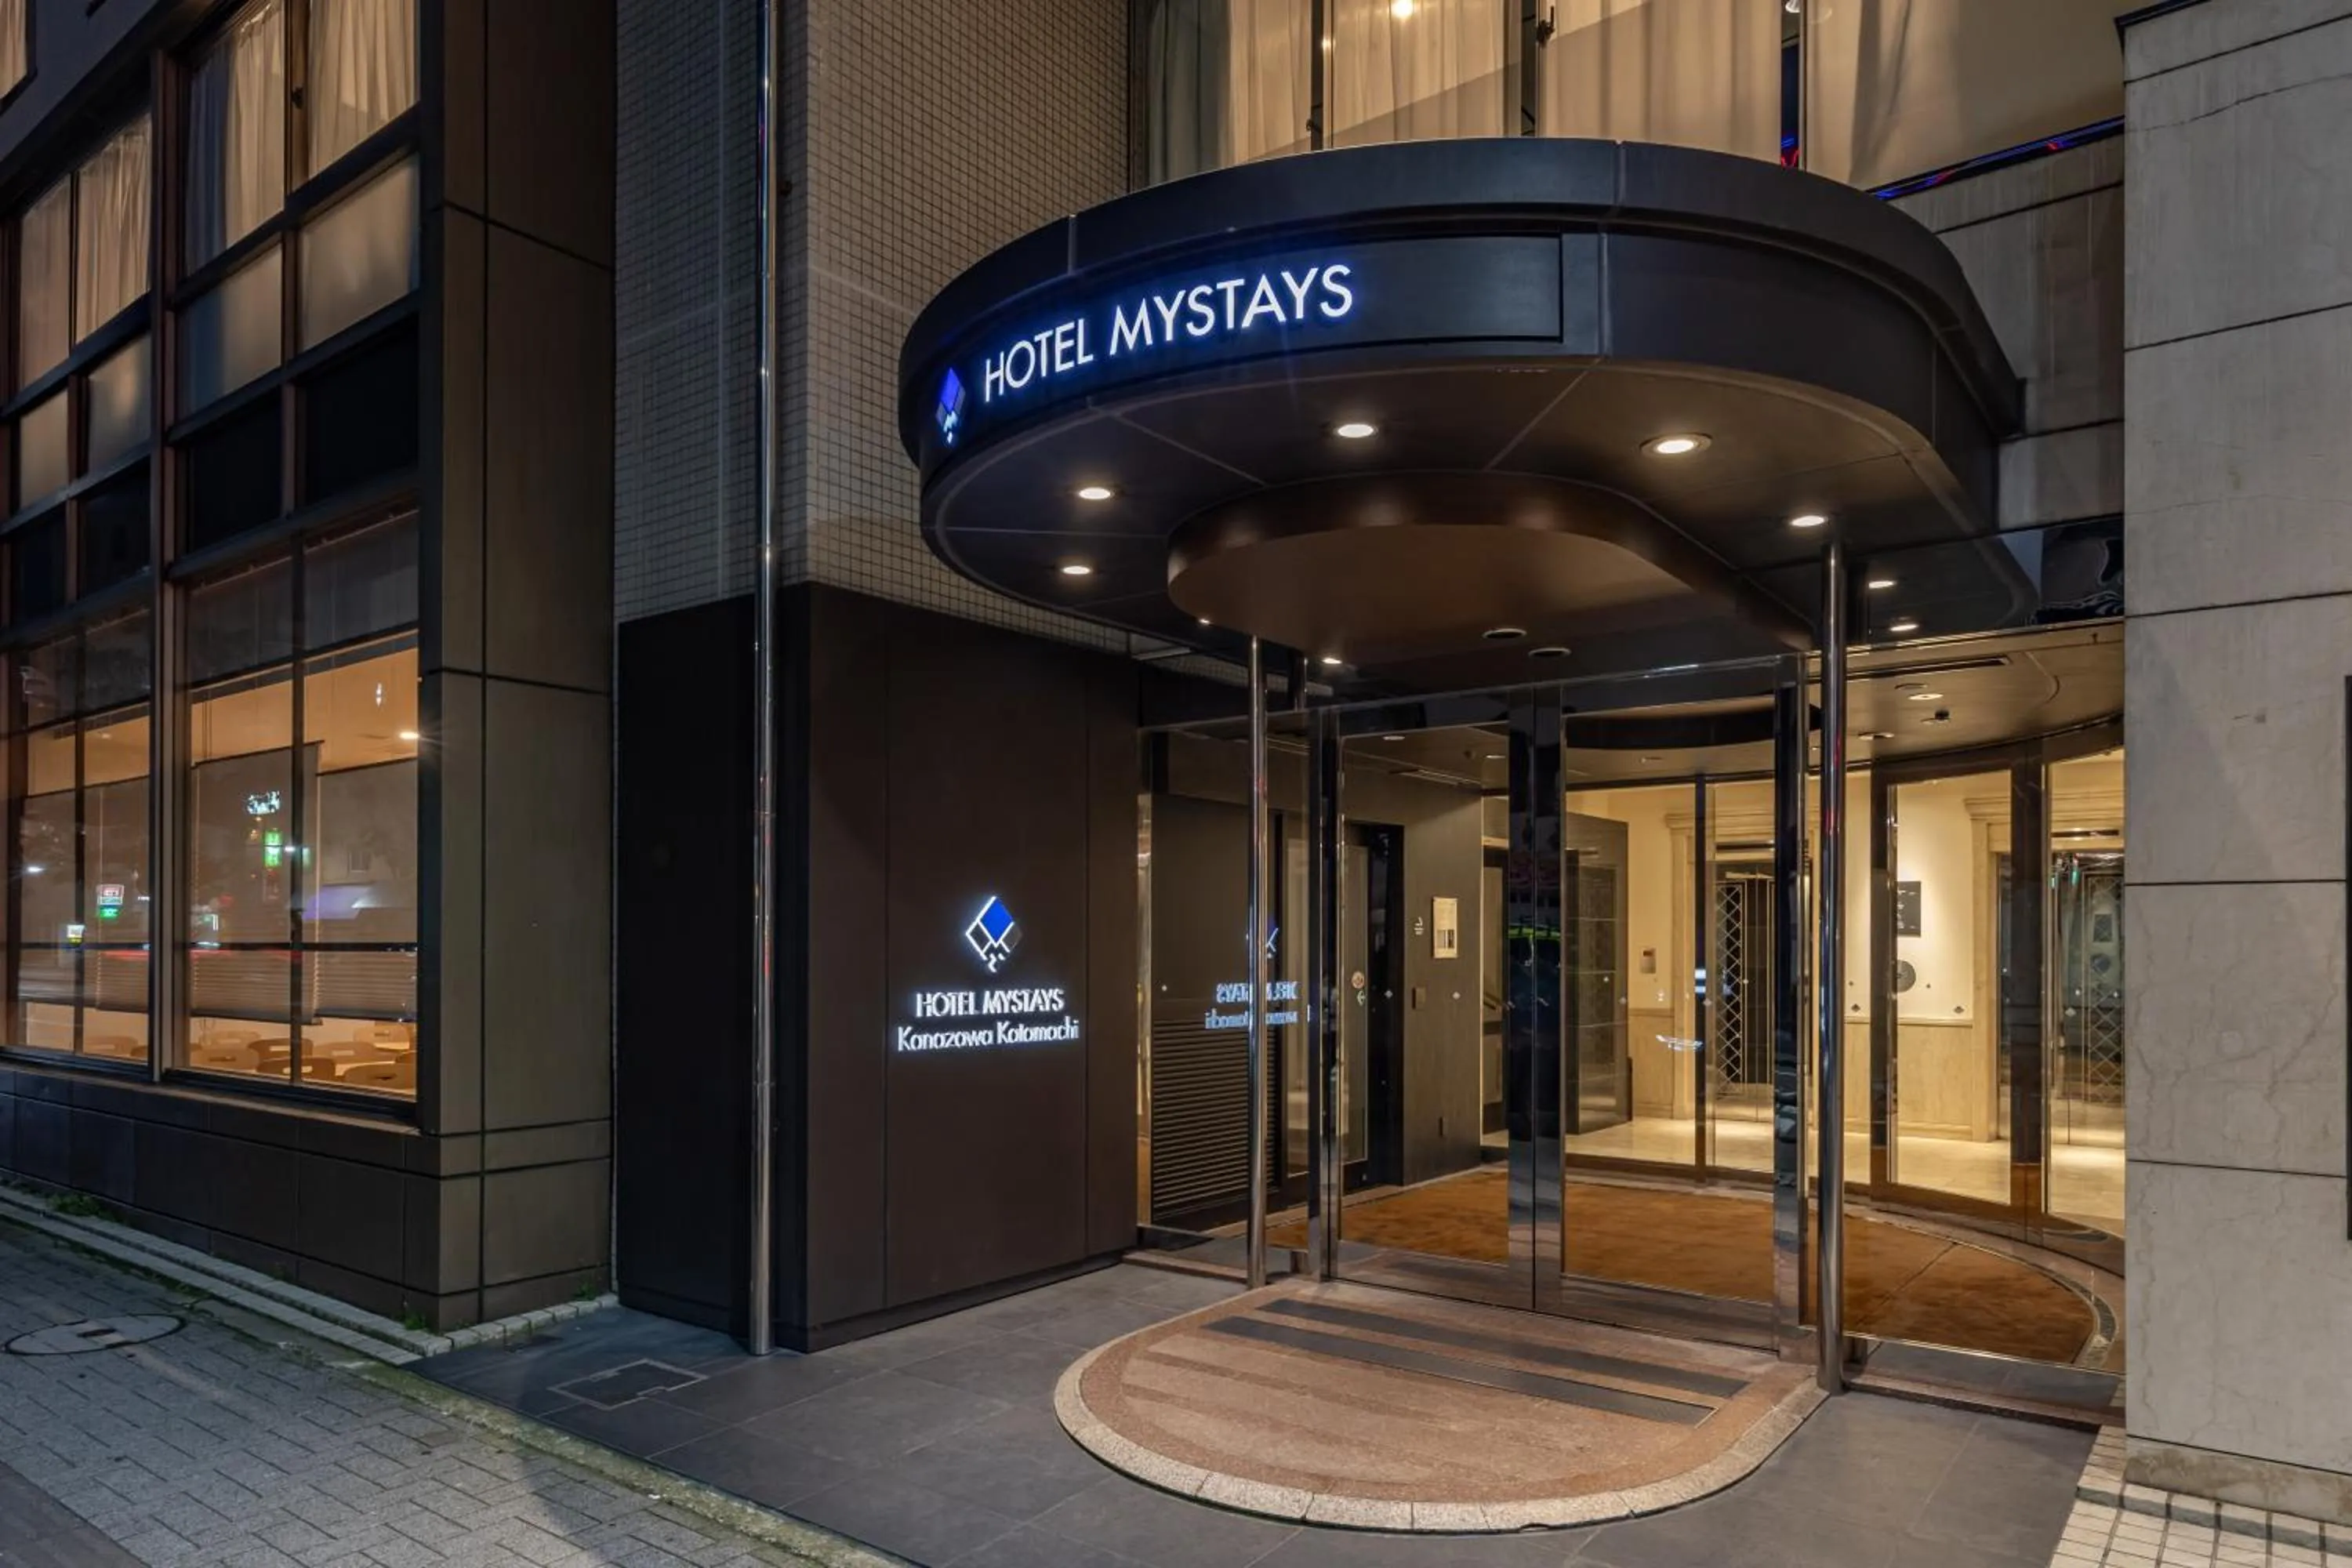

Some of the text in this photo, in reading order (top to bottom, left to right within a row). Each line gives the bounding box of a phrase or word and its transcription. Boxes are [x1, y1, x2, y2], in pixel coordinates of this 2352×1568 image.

[984, 264, 1354, 402] HOTEL MYSTAYS
[916, 988, 1065, 1018] HOTEL MYSTAYS
[898, 1015, 1080, 1051] Kanazawa Katamachi
